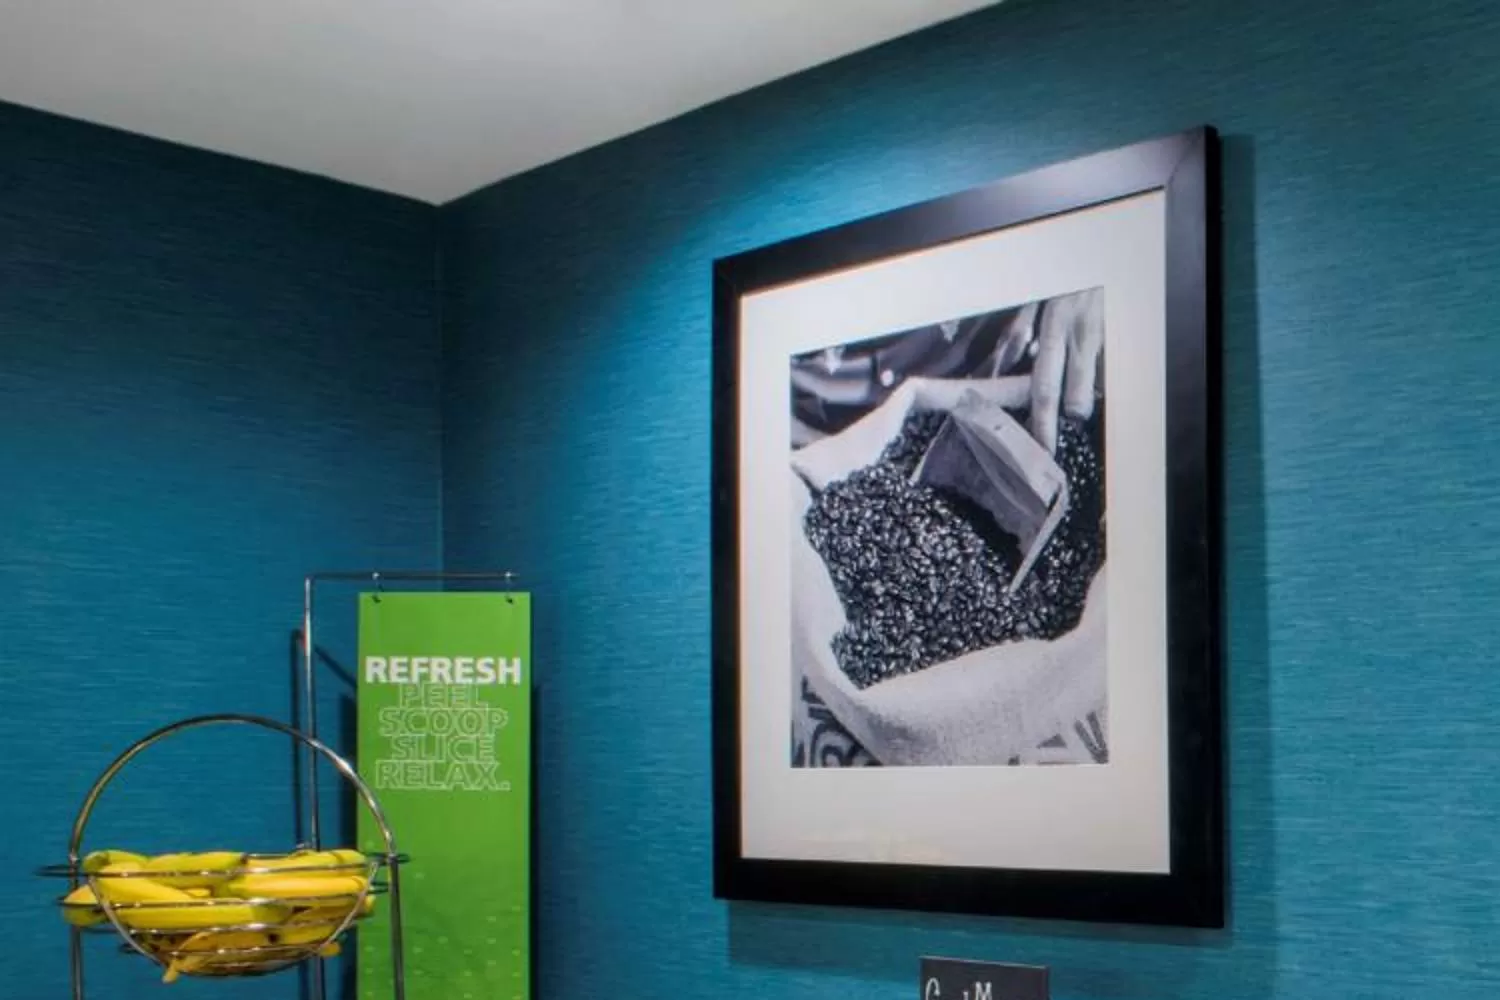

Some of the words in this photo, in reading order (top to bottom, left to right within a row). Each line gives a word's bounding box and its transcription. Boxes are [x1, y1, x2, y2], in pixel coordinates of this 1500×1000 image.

[365, 656, 521, 685] REFRESH
[400, 682, 489, 709] PEEL
[379, 707, 508, 737] SCOOP
[392, 734, 498, 763] SLICE
[375, 759, 511, 791] RELAX.
